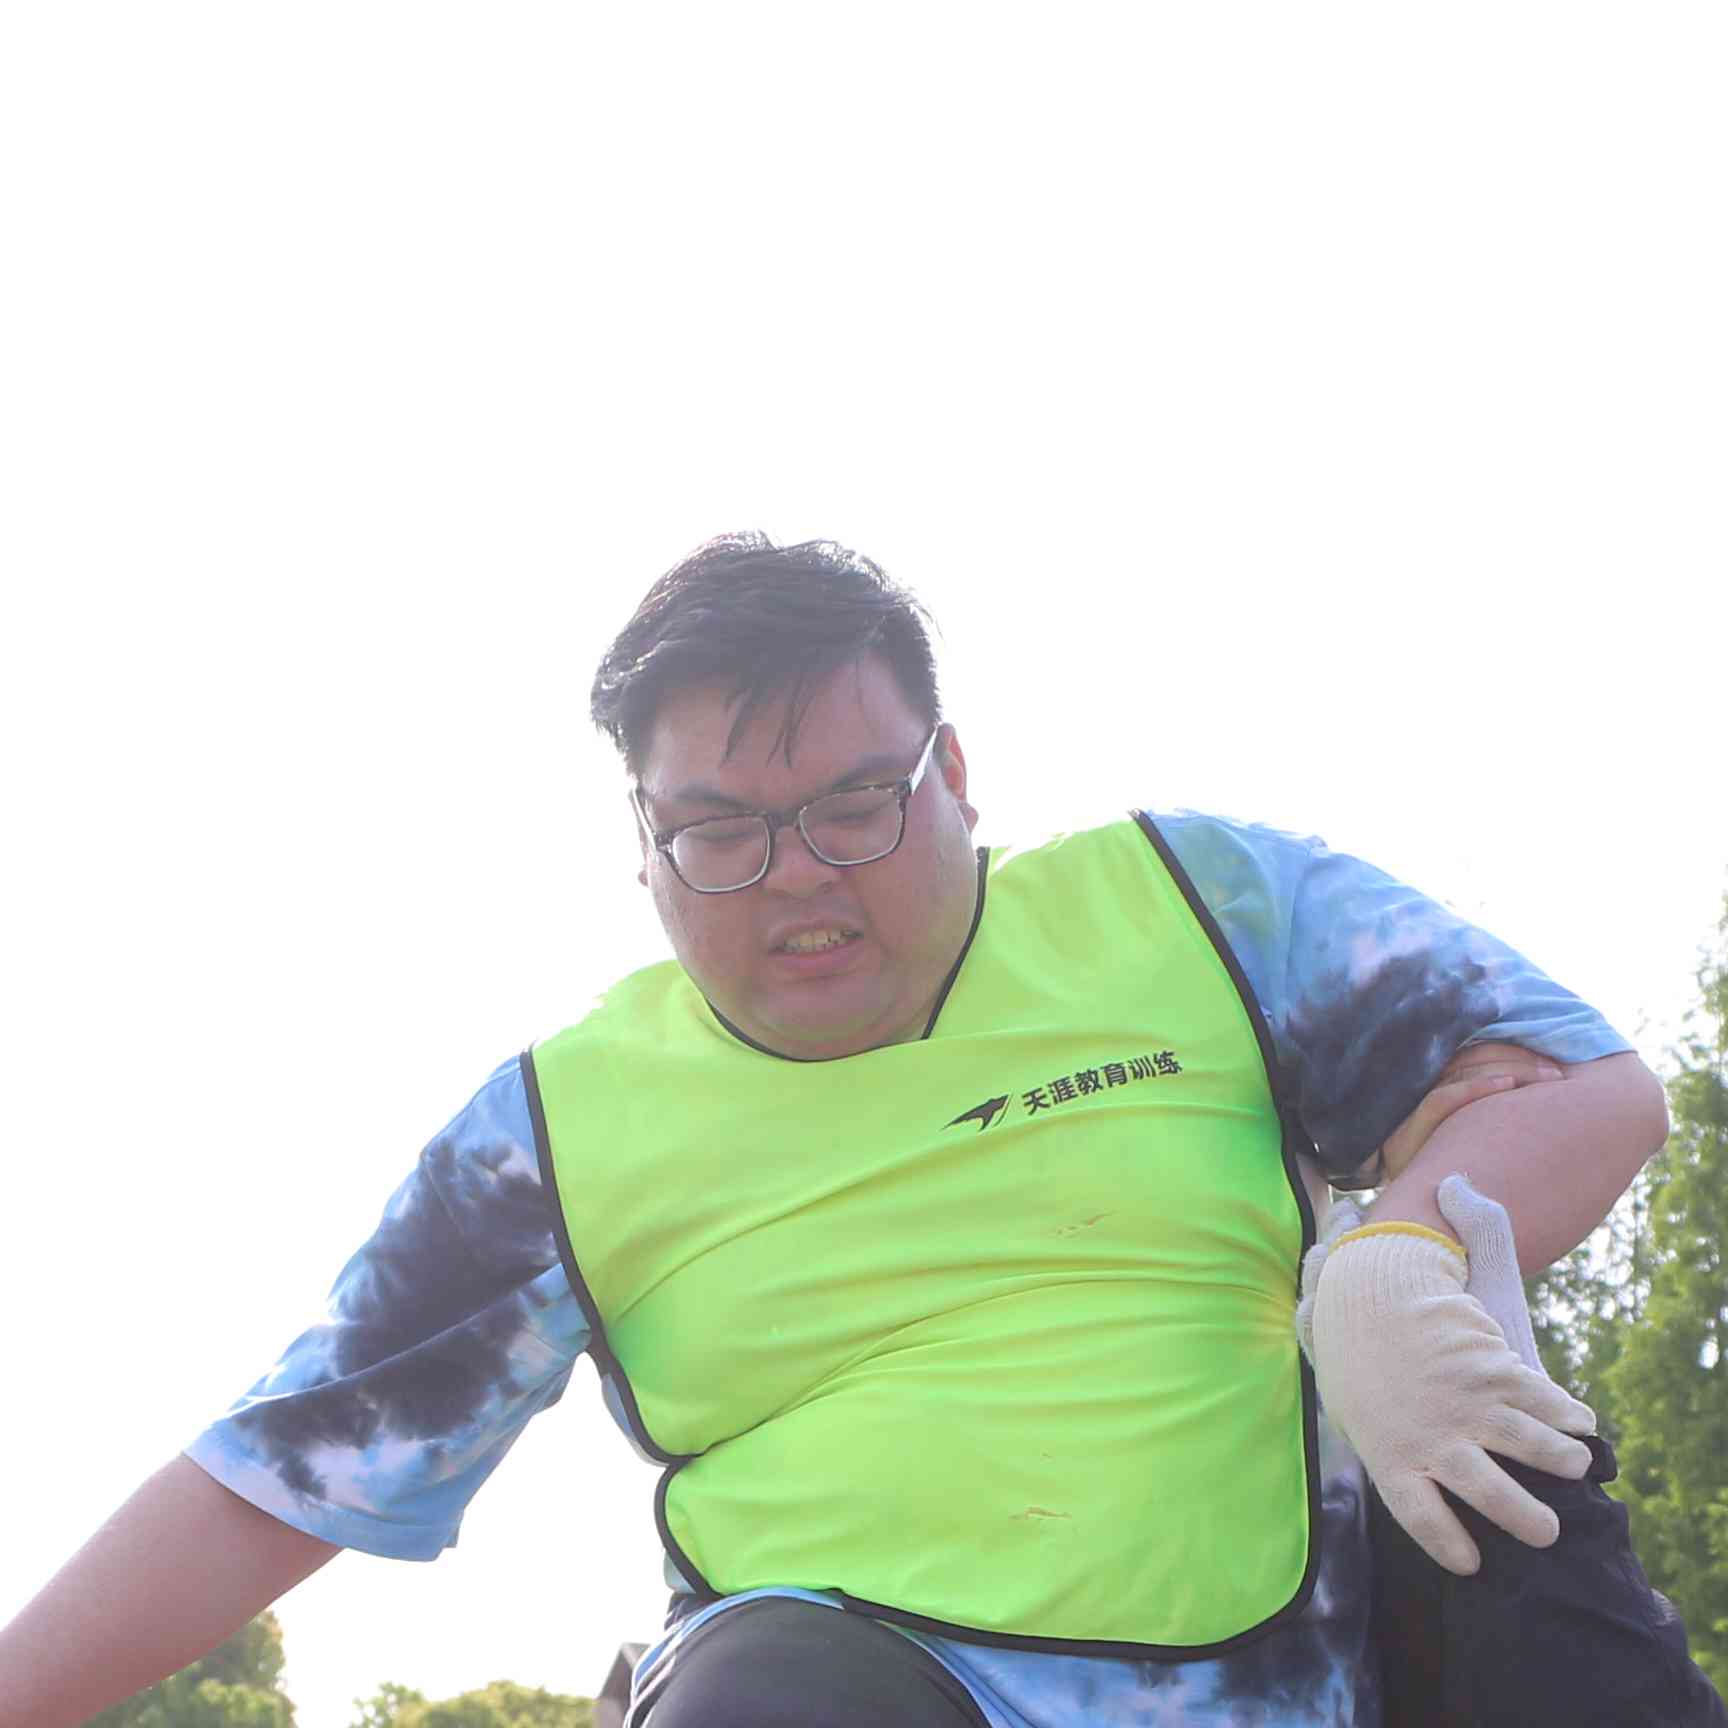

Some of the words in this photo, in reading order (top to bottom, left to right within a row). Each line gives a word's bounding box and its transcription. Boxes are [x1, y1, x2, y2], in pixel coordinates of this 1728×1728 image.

[1021, 1051, 1183, 1116] 天涯教育训练
